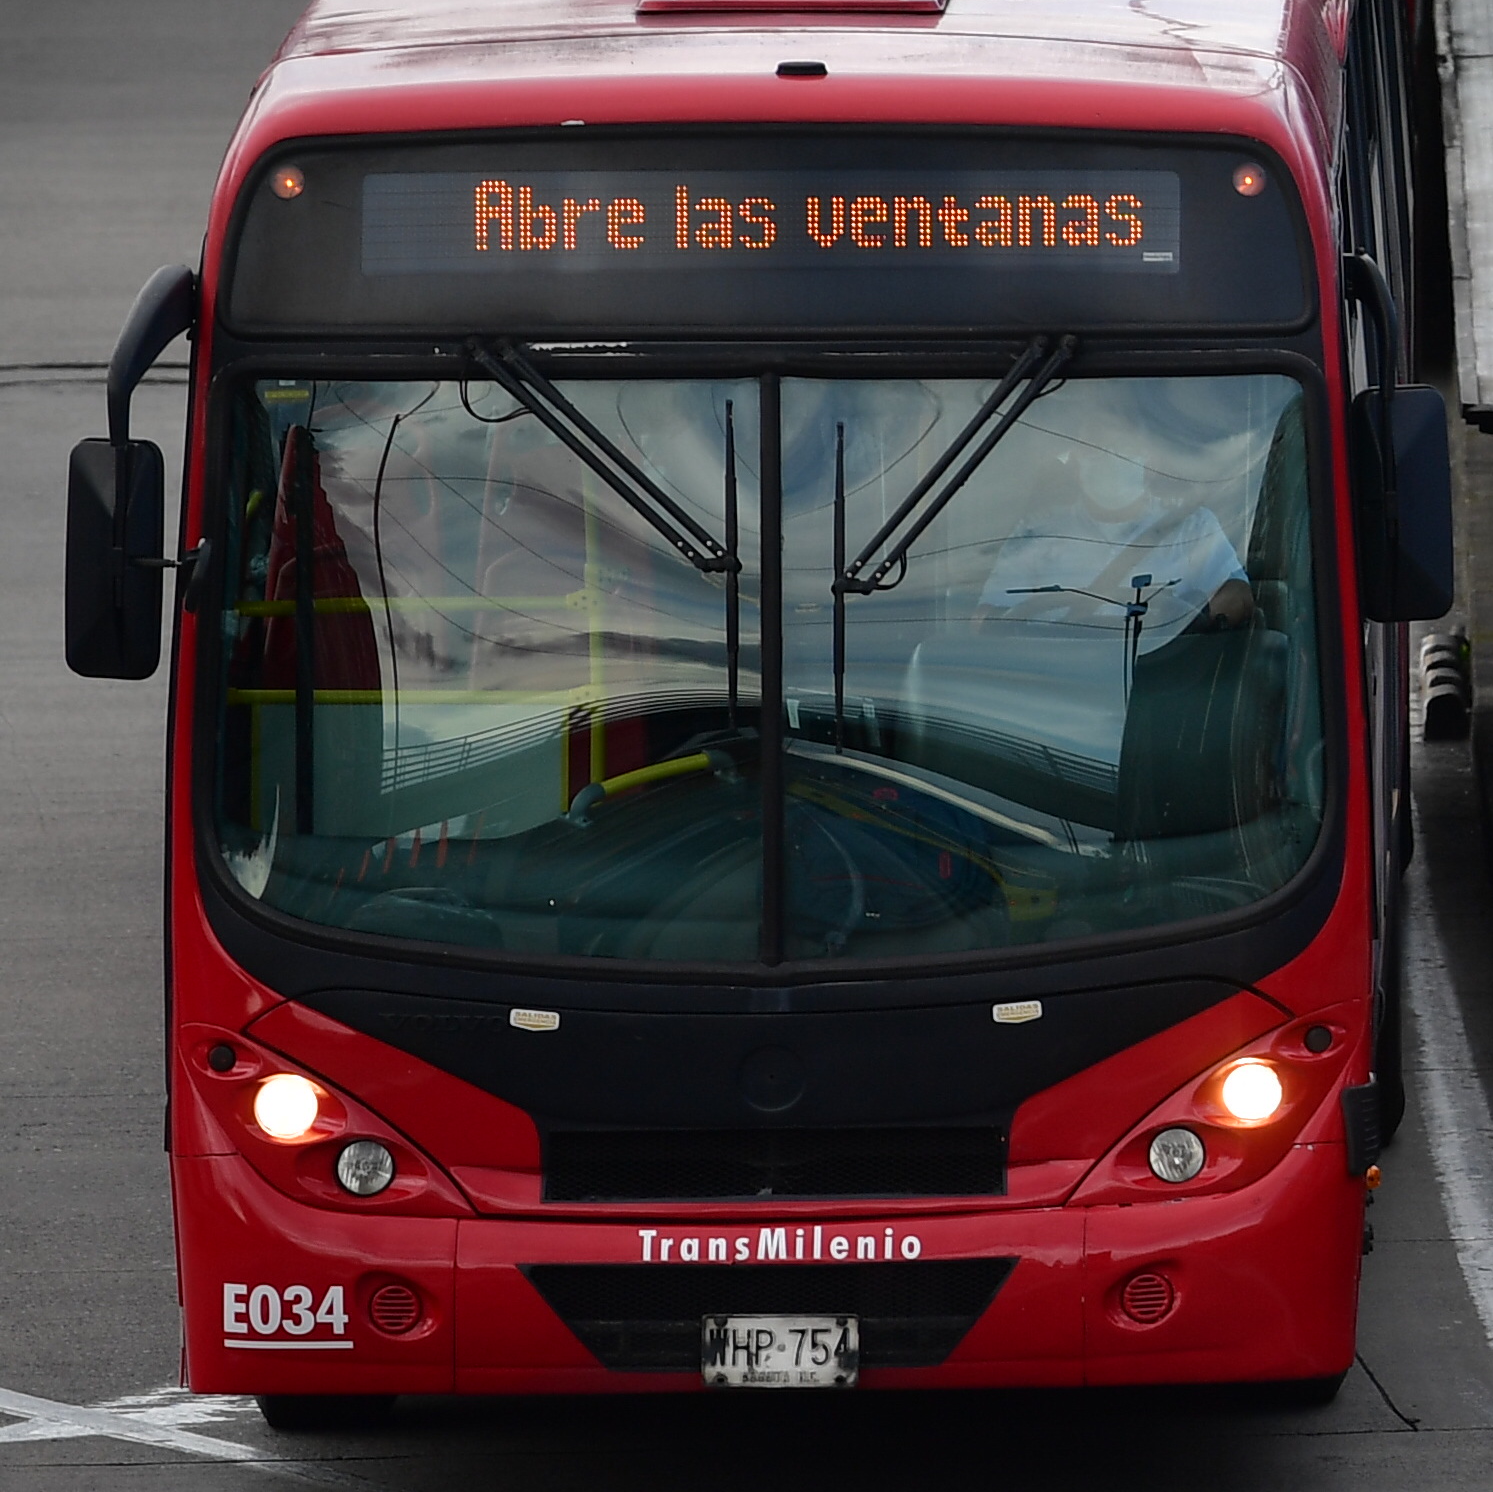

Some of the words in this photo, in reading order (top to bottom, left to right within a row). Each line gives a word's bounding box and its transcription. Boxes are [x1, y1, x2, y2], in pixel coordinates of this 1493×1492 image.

[474, 180, 645, 251] Abre
[676, 185, 777, 250] las
[806, 193, 1144, 250] ventanas
[638, 1225, 922, 1262] TransMilenio
[223, 1282, 350, 1335] E034
